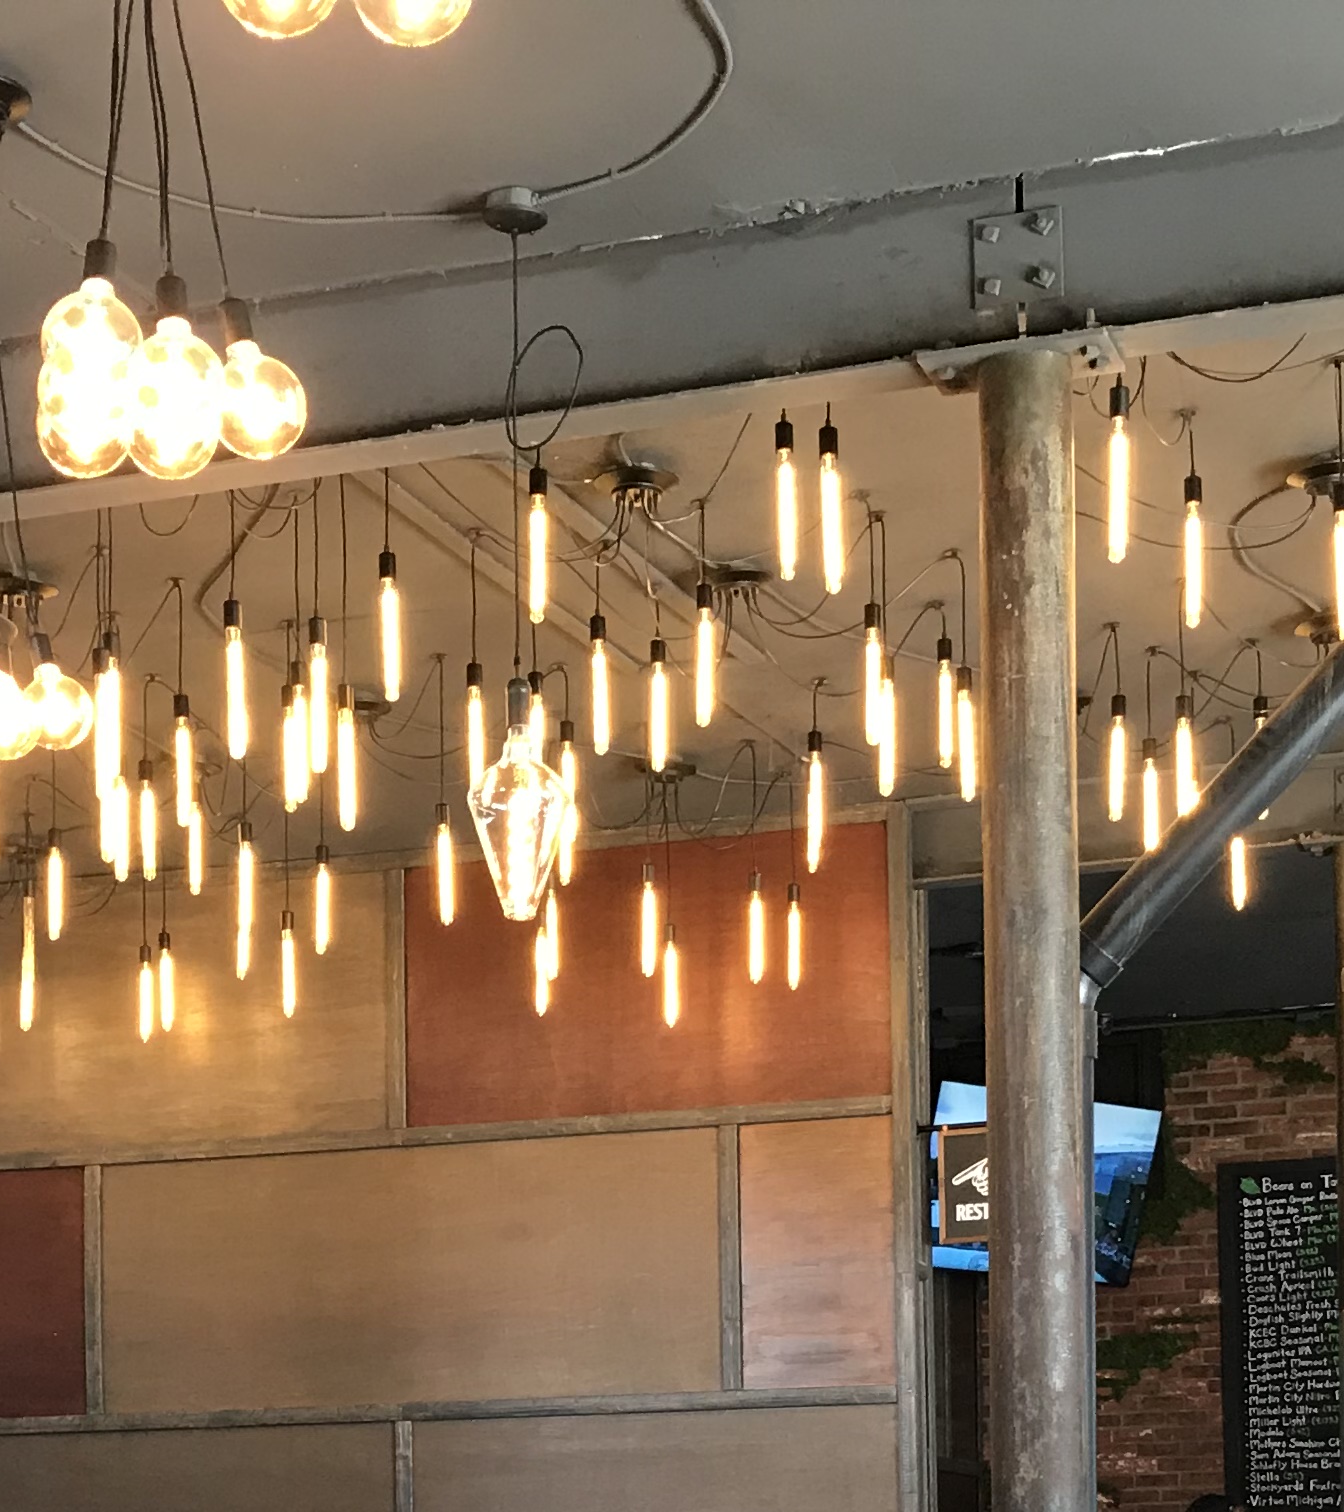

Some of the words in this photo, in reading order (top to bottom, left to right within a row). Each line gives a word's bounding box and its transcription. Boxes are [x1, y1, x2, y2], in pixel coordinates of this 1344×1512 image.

[1266, 1206, 1284, 1216] Pale
[1269, 1228, 1290, 1236] Tank
[1295, 1225, 1301, 1235] 7
[1270, 1237, 1303, 1247] Wheat
[1267, 1250, 1292, 1259] Moon
[1245, 1263, 1264, 1273] Bud
[1268, 1260, 1295, 1272] Light
[1247, 1295, 1275, 1303] Coors
[1279, 1291, 1307, 1303] Light
[1284, 1381, 1304, 1392] City
[1284, 1393, 1303, 1403] City
[1250, 1418, 1279, 1428] Miller
[1282, 1415, 1306, 1426] Light
[1250, 1427, 1284, 1438] Modelo
[1273, 1449, 1300, 1458] Adams
[1250, 1472, 1279, 1482] Stella
[1286, 1495, 1333, 1509] Michigan
